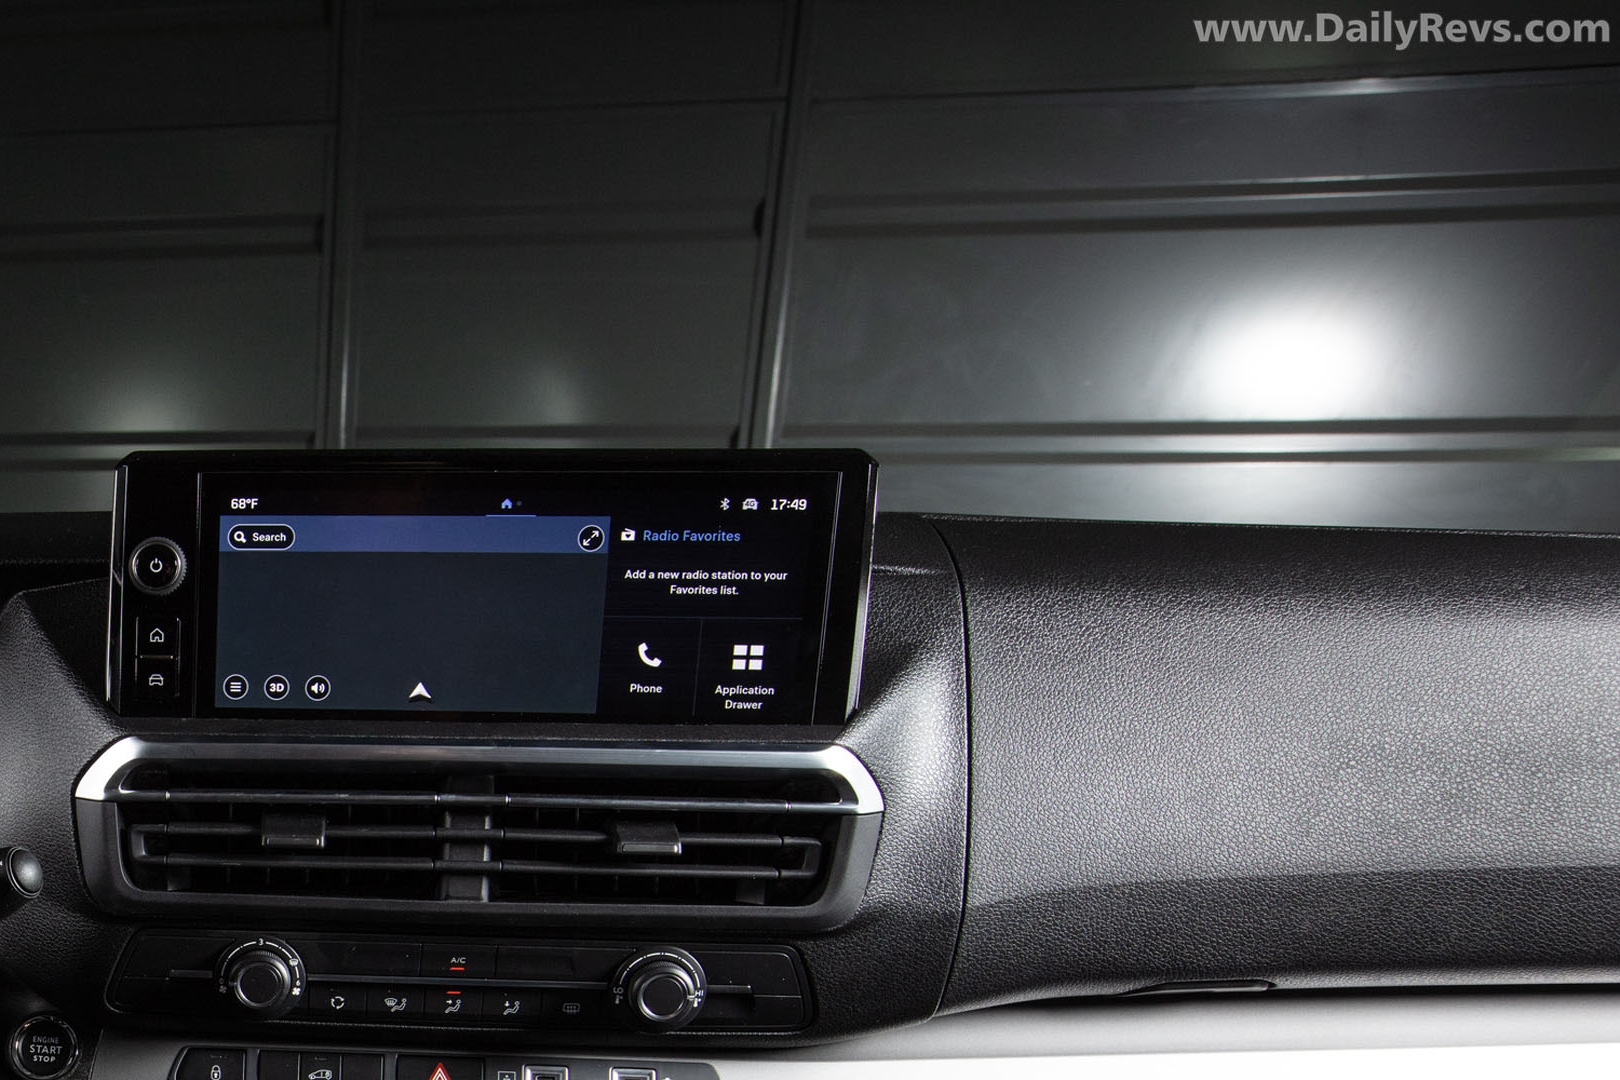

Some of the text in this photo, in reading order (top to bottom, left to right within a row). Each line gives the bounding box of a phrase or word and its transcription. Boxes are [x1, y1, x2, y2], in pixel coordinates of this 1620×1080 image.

[231, 498, 259, 509] 68°F
[770, 499, 807, 511] 17:49
[252, 532, 287, 542] Search
[643, 529, 741, 542] Radio Favorites
[624, 569, 647, 579] Add
[657, 571, 679, 579] new
[682, 570, 709, 580] radio
[711, 570, 748, 580] station
[750, 571, 762, 580] to
[764, 572, 788, 582] your
[670, 585, 739, 595] Favorites list.
[269, 683, 285, 692] 3D
[630, 683, 663, 693] Phone
[715, 685, 775, 697] Application
[724, 699, 763, 709] Drawer
[32, 1035, 60, 1044] ENGINE
[29, 1044, 63, 1055] START
[33, 1055, 57, 1063] STOP
